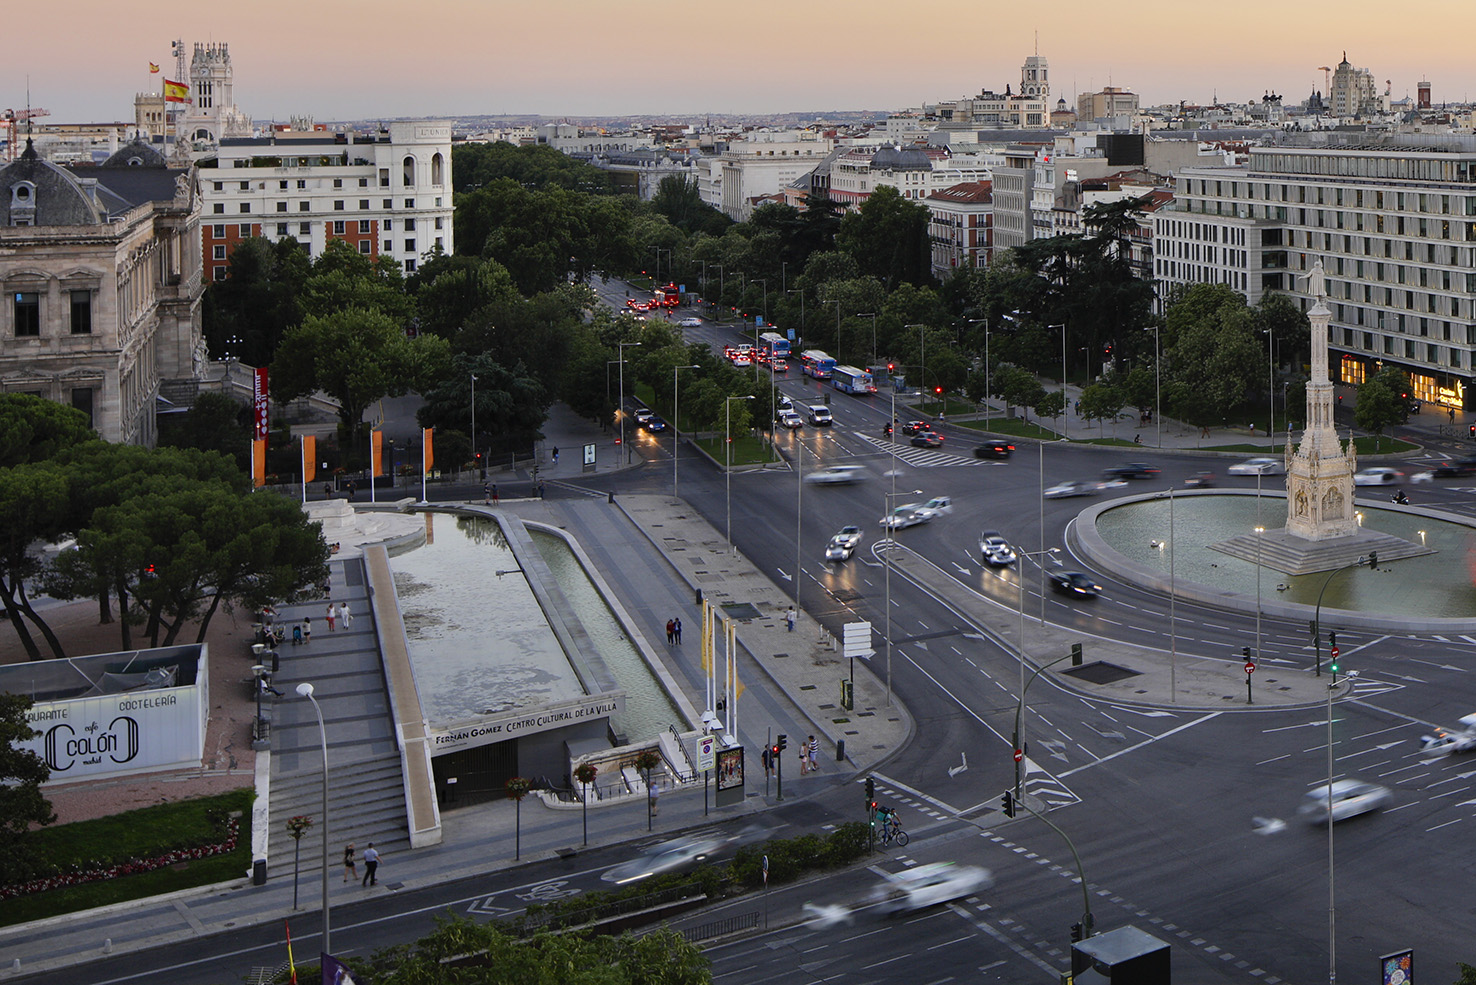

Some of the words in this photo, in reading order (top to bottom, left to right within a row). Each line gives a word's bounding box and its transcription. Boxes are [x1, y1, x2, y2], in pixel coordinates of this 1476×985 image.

[119, 695, 176, 711] COCTELERÍA
[435, 731, 469, 745] FERNÁN
[470, 725, 502, 738] GÓMEZ
[506, 719, 536, 732] CENTRO
[537, 712, 573, 727] CULTURAL
[575, 708, 584, 718] DE
[585, 707, 595, 716] LA
[595, 703, 617, 715] VILLA
[67, 732, 117, 756] COLÓN
